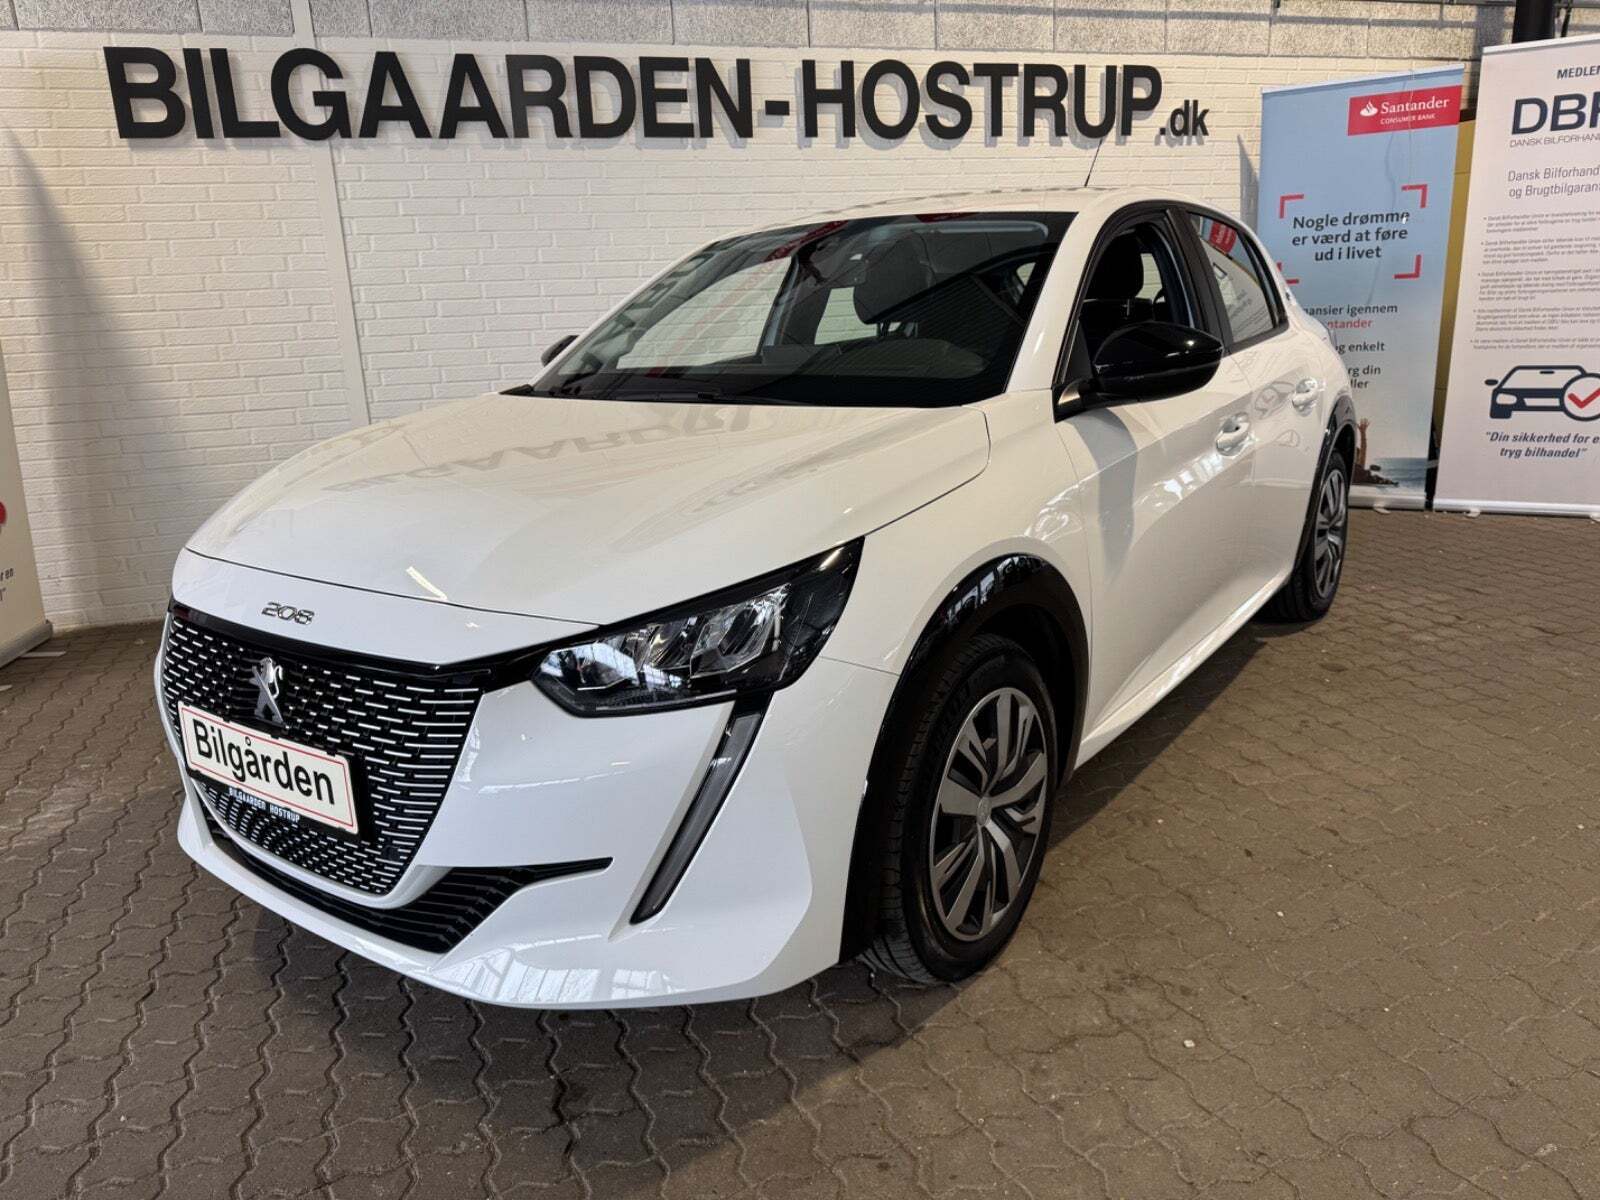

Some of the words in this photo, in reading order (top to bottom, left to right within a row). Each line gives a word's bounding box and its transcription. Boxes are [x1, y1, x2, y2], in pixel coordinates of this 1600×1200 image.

[1380, 95, 1450, 114] Santander
[1380, 115, 1416, 125] CONSUMER
[1417, 113, 1436, 121] BANK
[1509, 138, 1543, 148] DANSK
[1508, 168, 1541, 182] Dansk
[1543, 164, 1600, 180] Bilforhand
[1509, 188, 1523, 199] og
[1293, 213, 1339, 231] Nogle
[1342, 212, 1410, 225] drømme
[1292, 235, 1308, 246] er
[1312, 229, 1351, 245] værd
[1354, 229, 1371, 242] at
[1375, 227, 1408, 241] føre
[1314, 247, 1334, 261] ud
[1338, 246, 1342, 260] i
[1346, 246, 1382, 260] livet
[1346, 304, 1398, 317] igennem
[1348, 341, 1385, 352] enkelt
[1362, 365, 1381, 375] din
[1511, 431, 1572, 443] sikkerhed
[1573, 432, 1591, 444] for
[1500, 447, 1522, 459] tryg
[261, 601, 315, 625] 208
[193, 719, 335, 805] Bilgården
[228, 787, 267, 811] BILGAARDEN
[269, 802, 300, 824] HOSTRUP
